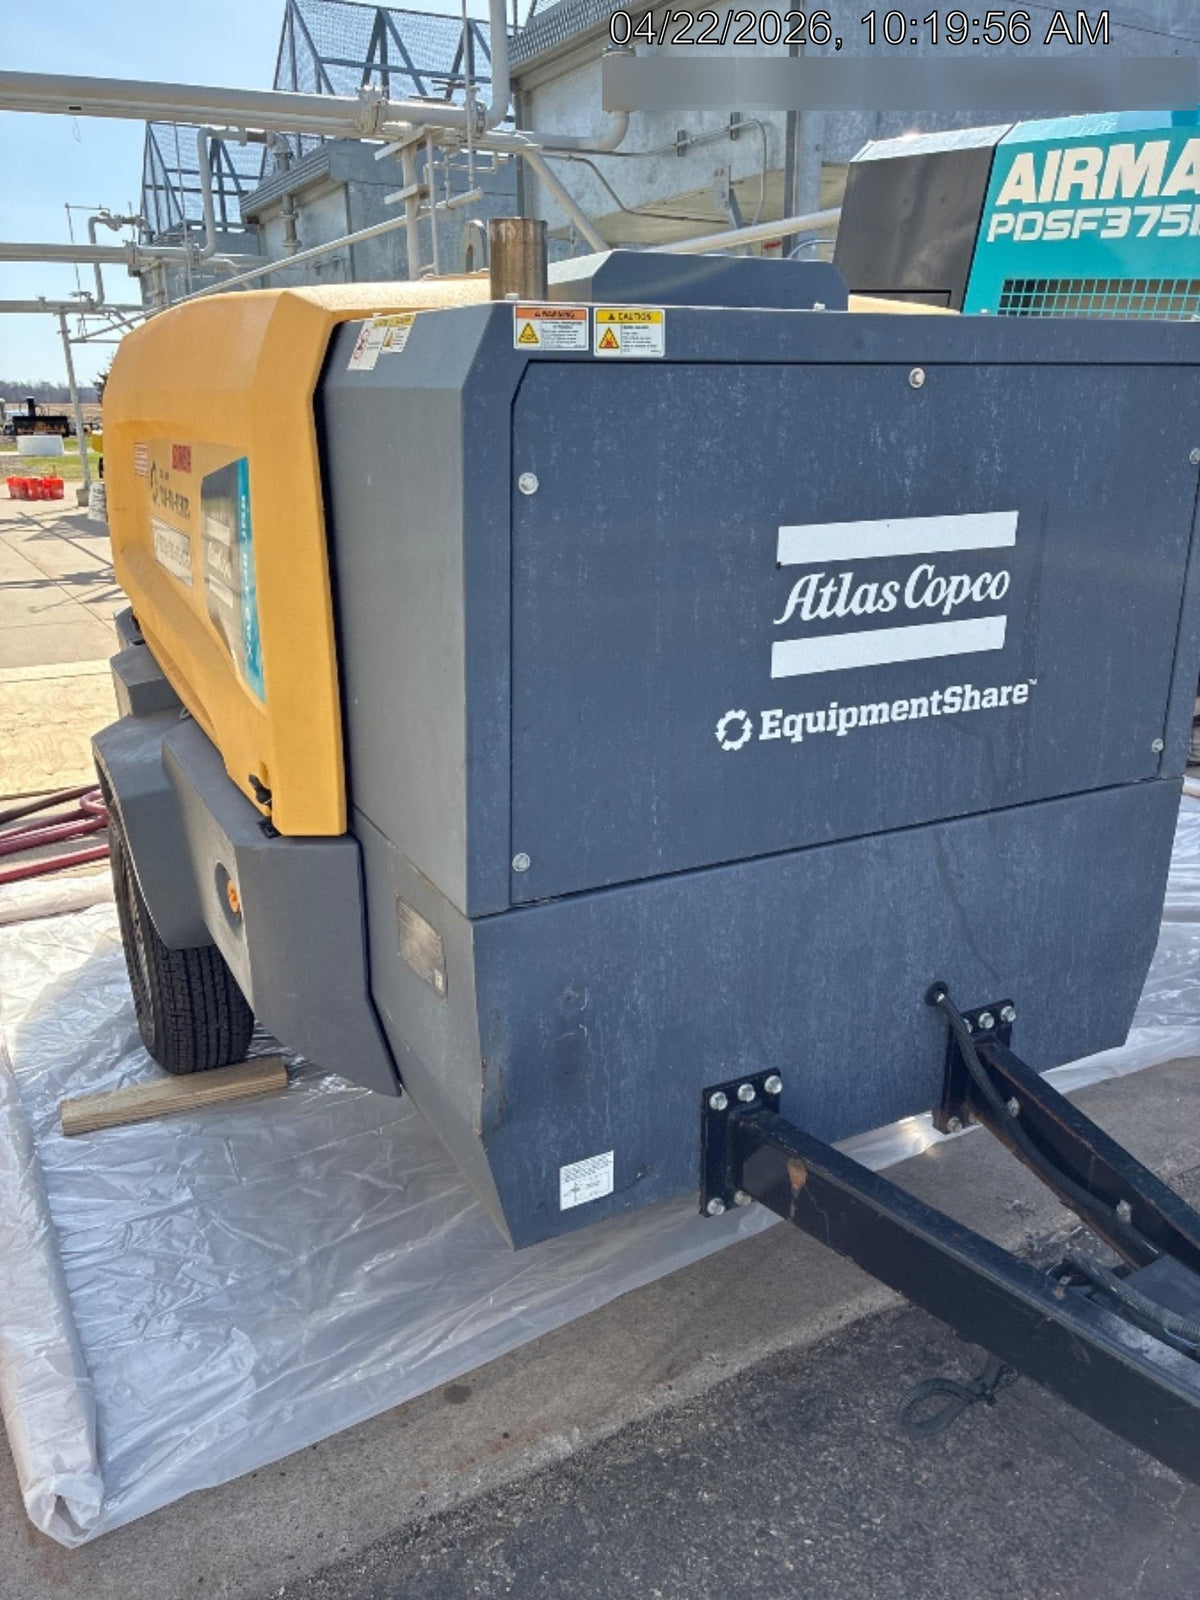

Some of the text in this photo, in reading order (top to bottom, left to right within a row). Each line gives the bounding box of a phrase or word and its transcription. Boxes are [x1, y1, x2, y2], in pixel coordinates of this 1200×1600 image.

[618, 312, 652, 322] CAUTION
[773, 563, 1011, 625] Atlas Copco
